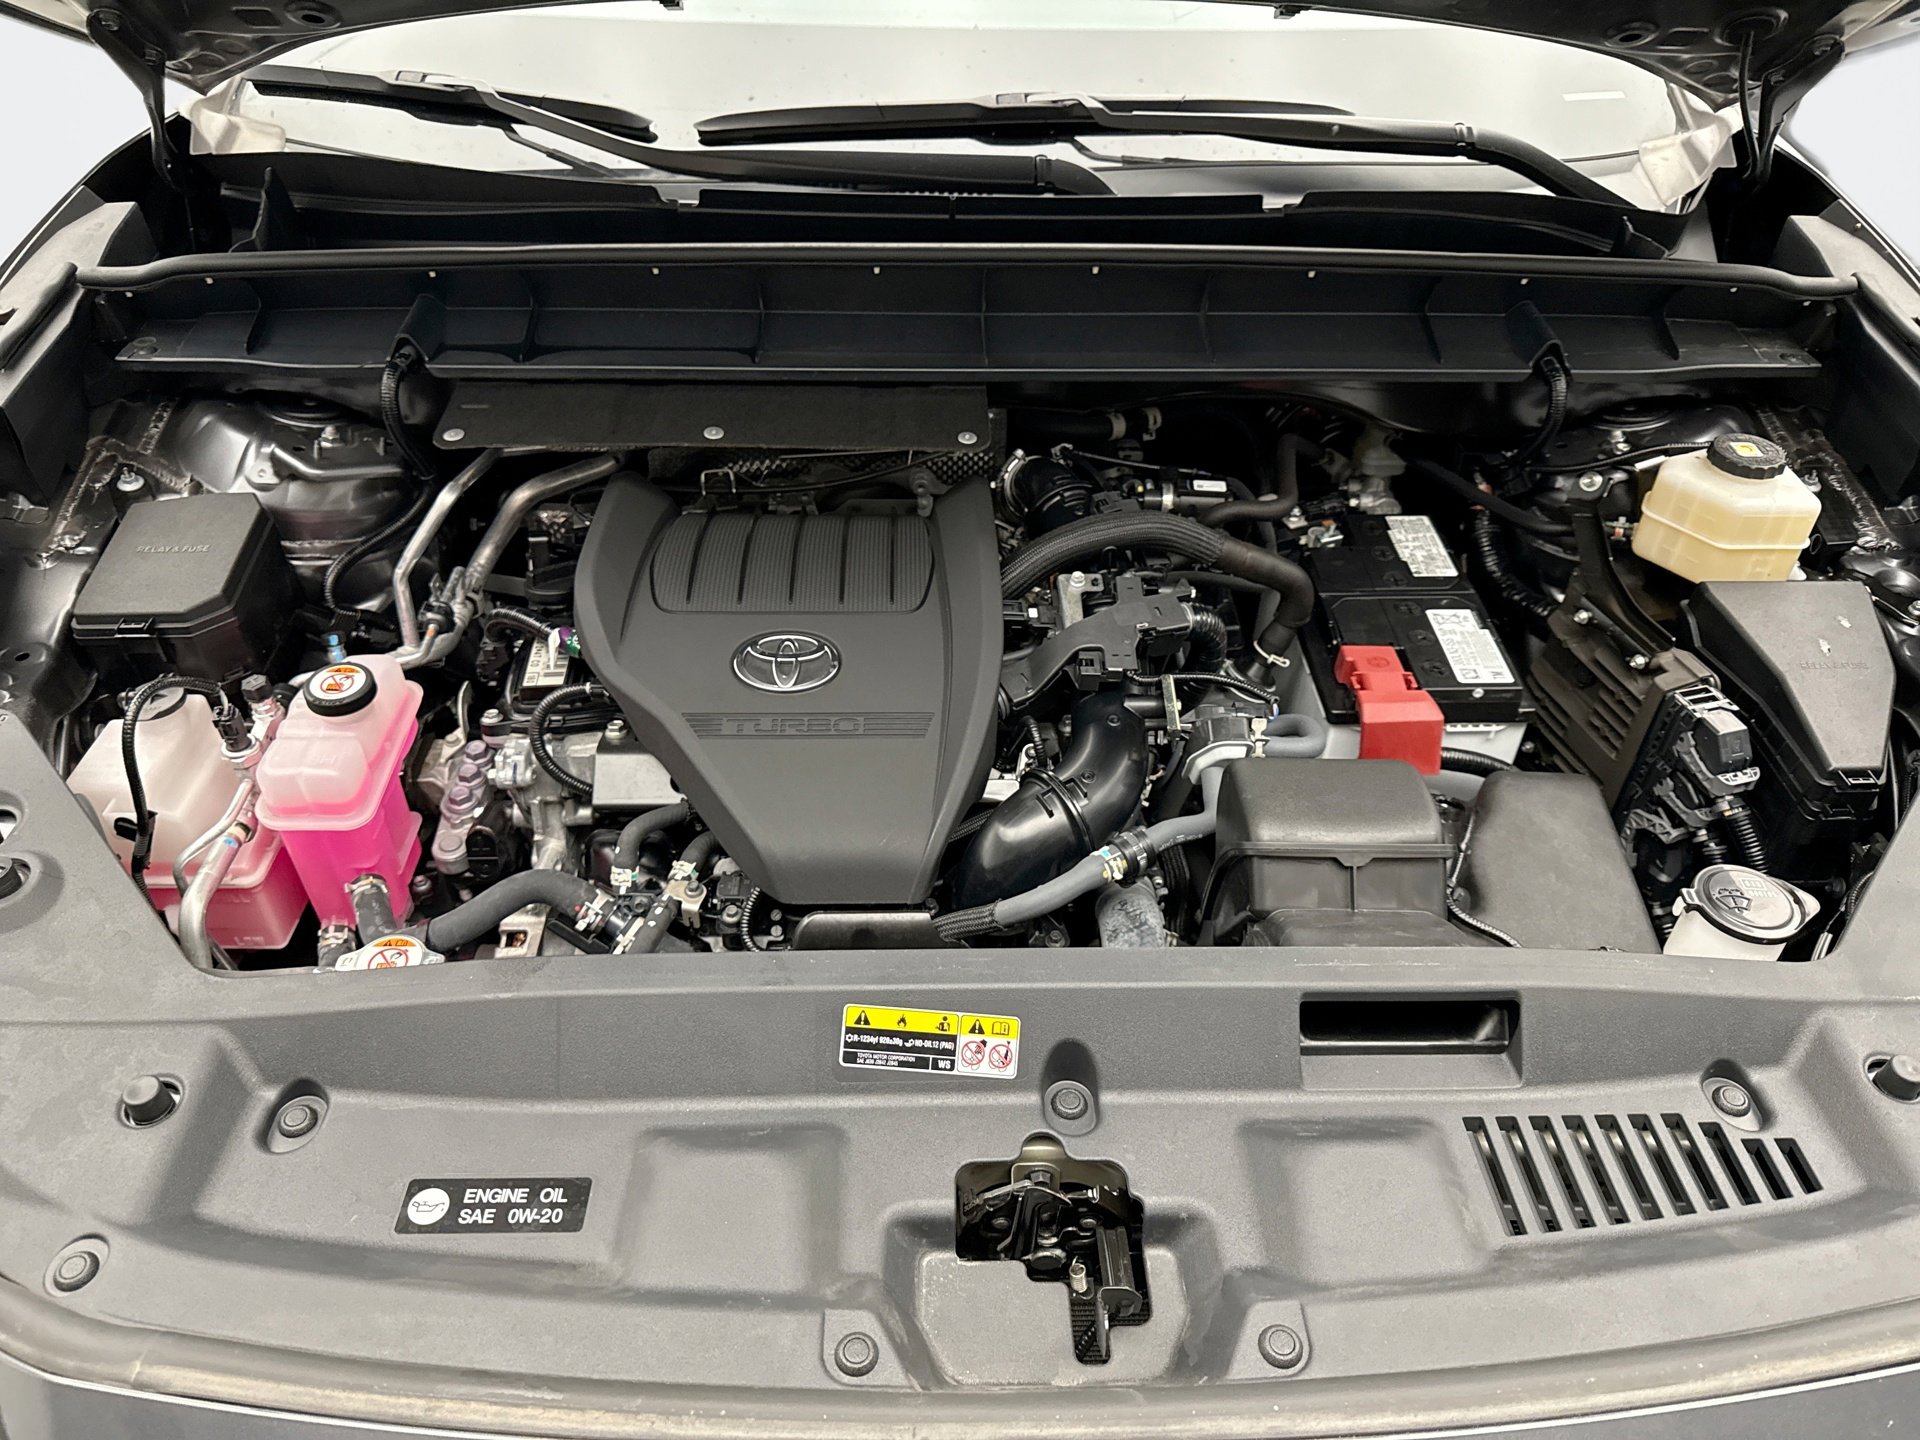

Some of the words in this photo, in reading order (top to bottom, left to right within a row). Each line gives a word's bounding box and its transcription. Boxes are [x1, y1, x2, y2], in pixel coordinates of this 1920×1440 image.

[726, 717, 860, 734] TURBO
[887, 1054, 916, 1063] CORPORATION
[938, 1060, 951, 1070] WS
[463, 1188, 529, 1204] ENGINE
[539, 1187, 568, 1204] OIL
[458, 1208, 496, 1224] SAE
[507, 1208, 563, 1224] 0W-20
